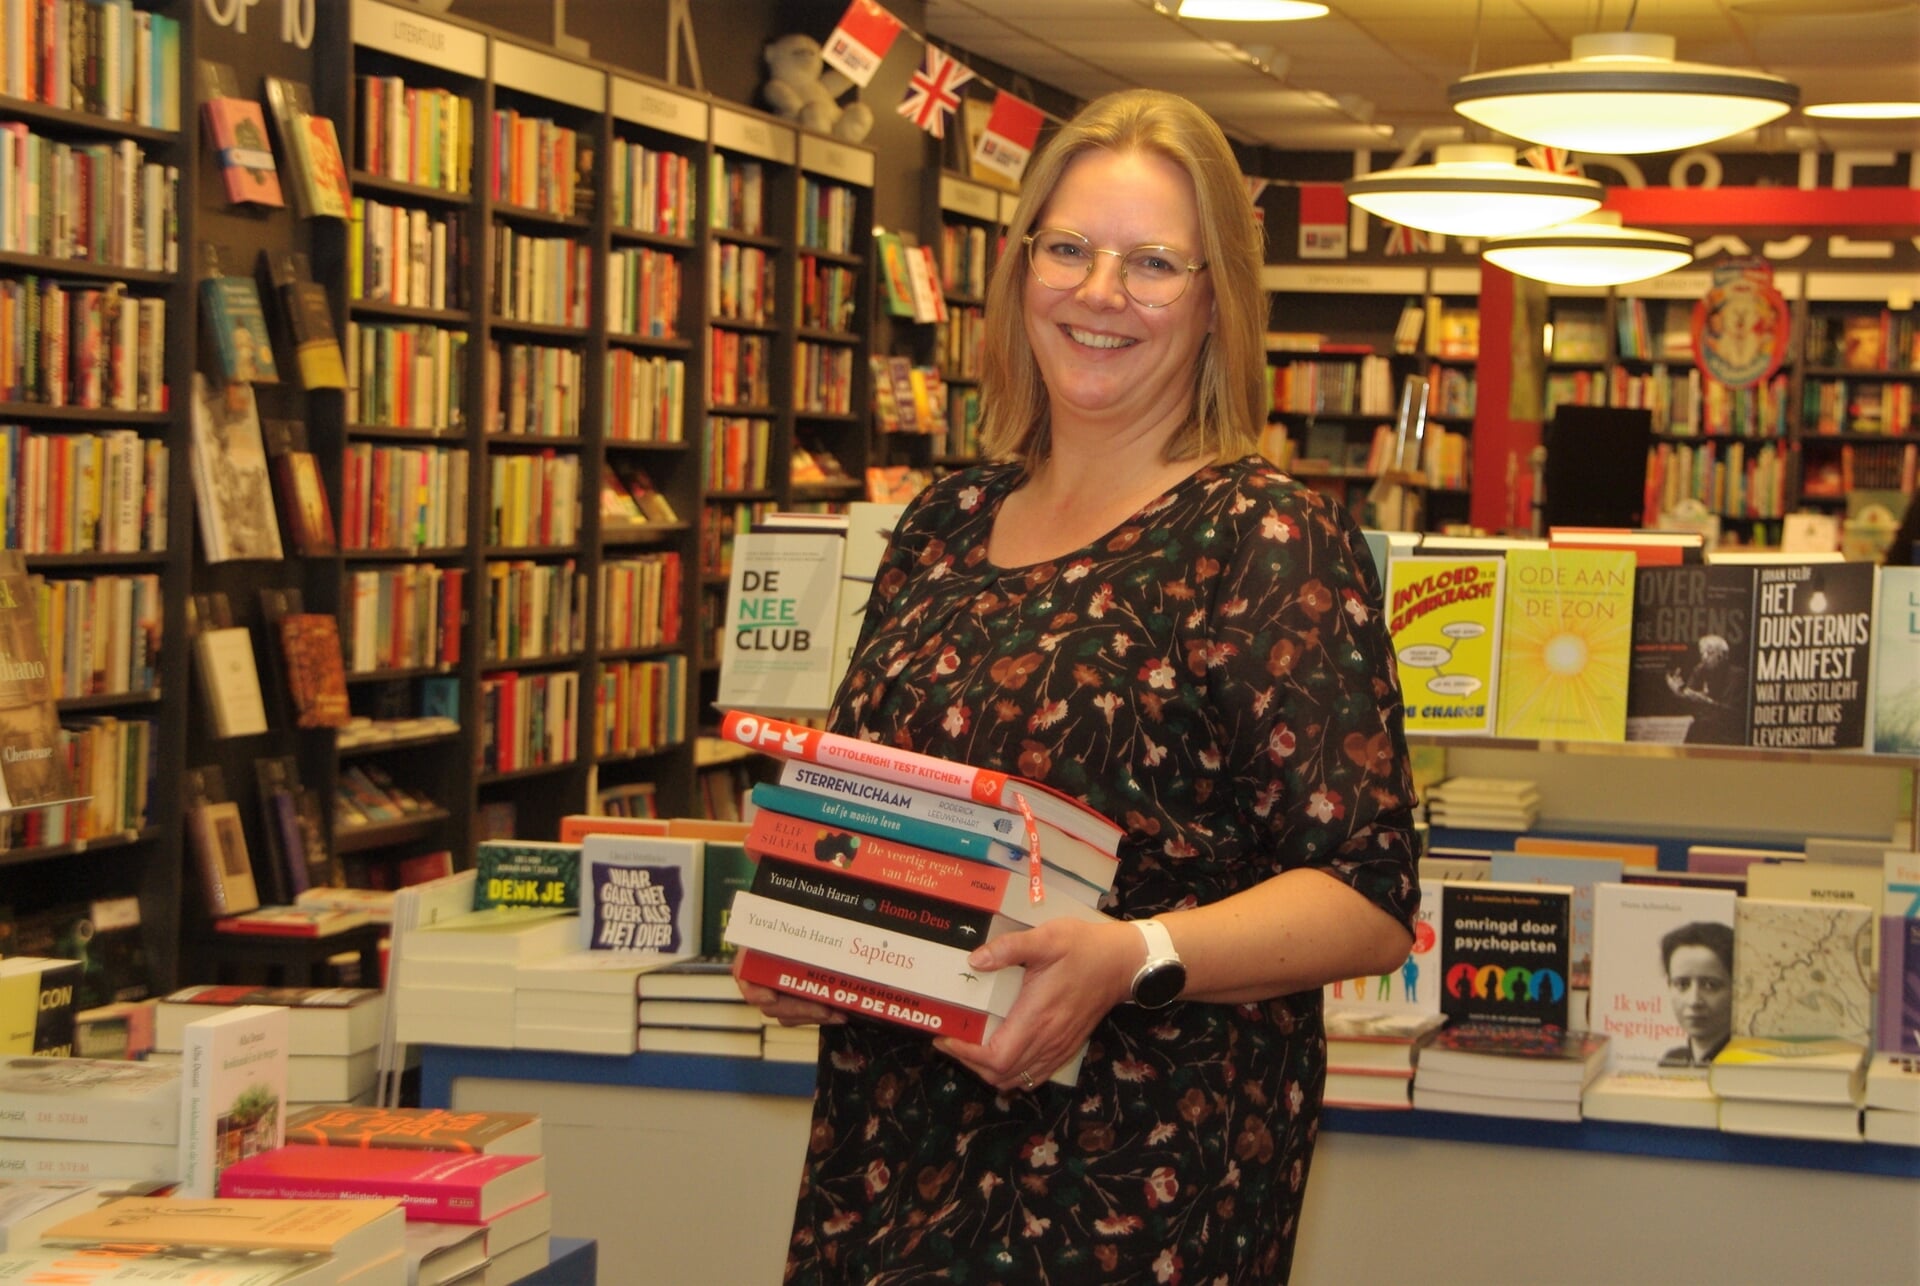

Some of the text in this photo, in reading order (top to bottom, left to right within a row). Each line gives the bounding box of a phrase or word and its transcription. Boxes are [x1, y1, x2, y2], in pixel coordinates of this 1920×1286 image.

[742, 569, 780, 592] DE
[1519, 566, 1626, 587] ODE AAN
[1640, 569, 1707, 606] OVER
[1393, 565, 1479, 615] INVLOED
[1761, 583, 1797, 615] HET
[738, 597, 797, 620] NEE
[1526, 599, 1616, 619] DE ZON
[1657, 607, 1744, 644] GRENS
[1759, 612, 1869, 647] DUISTERNIS
[736, 628, 811, 652] CLUB
[1757, 647, 1855, 681] MANIFEST
[1755, 681, 1858, 702] WAT KUNSTLICHT
[1754, 703, 1842, 725] DOET MET ONS
[1753, 725, 1837, 746] LEVENSRITME
[829, 745, 962, 785] OTTOLENGHI TEST KITCHEN
[795, 769, 912, 809] STERRENLICHAAM
[822, 802, 902, 831] Leef je mooiste leven
[927, 809, 980, 829] LEEUWENHART
[938, 801, 975, 816] RODERICK
[775, 822, 804, 837] ELIF
[761, 833, 808, 855] SHAFAK
[867, 842, 964, 877] De veertig regels
[608, 868, 651, 889] WAAR
[882, 867, 938, 889] van liefde
[487, 878, 565, 903] DENK JE
[602, 882, 667, 906] GAAT HET
[770, 872, 951, 930] Yuval Noah Harari Homo Deus
[602, 903, 672, 924] OVER ALS
[1454, 916, 1558, 935] omringd door
[600, 920, 673, 947] HET OVER
[749, 913, 916, 970] Yuval Noah Harari Sapiens
[1454, 935, 1558, 954] psychopaten
[40, 985, 73, 1011] CON
[779, 973, 942, 1029] BIJNA OP DE RADIO
[807, 970, 921, 1008] NICO DIJKSHOORN
[1613, 992, 1662, 1014] Ik wil
[1603, 1014, 1688, 1040] begrijpen
[402, 1194, 438, 1206] Dromen
